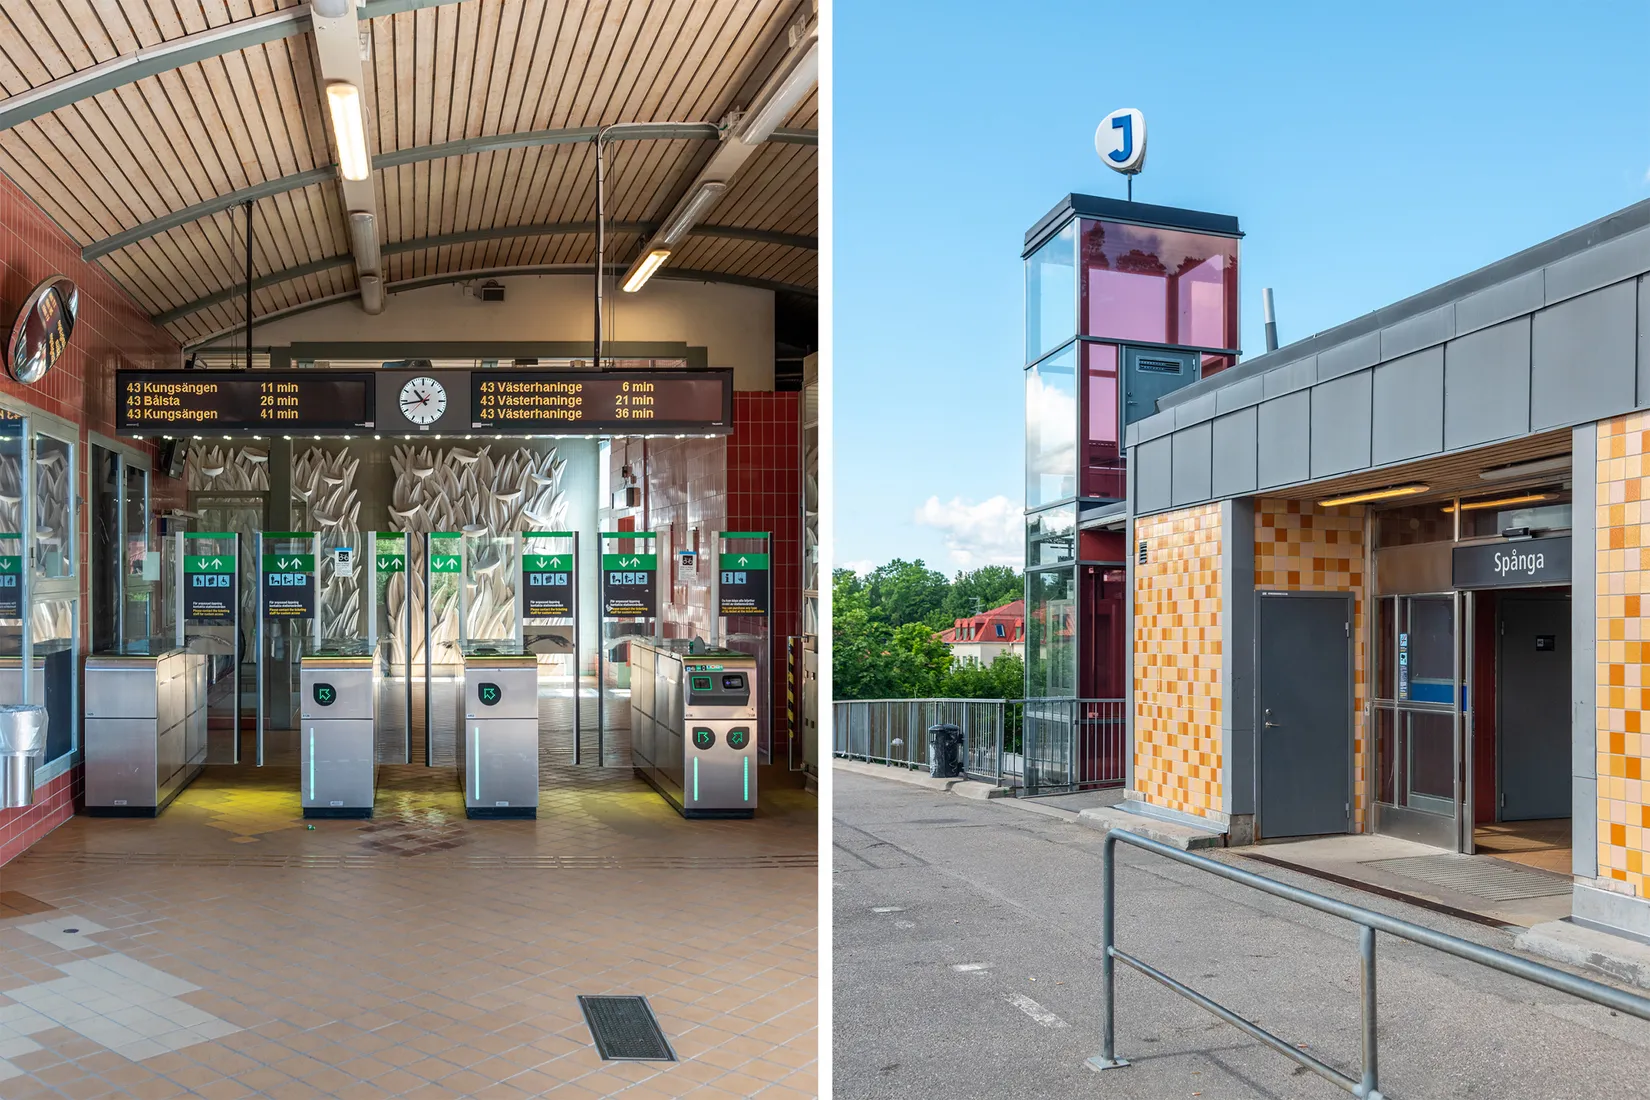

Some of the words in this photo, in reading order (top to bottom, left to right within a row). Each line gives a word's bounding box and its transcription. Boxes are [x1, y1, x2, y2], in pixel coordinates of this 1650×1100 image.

[1108, 114, 1133, 162] J
[127, 383, 141, 393] 43
[144, 383, 217, 395] Kungsängen
[261, 383, 273, 393] 11
[277, 383, 299, 393] min
[480, 382, 494, 393] 43
[497, 382, 583, 395] Västerhaninge
[622, 382, 630, 393] 6
[632, 382, 654, 393] min
[127, 396, 141, 406] 43
[144, 396, 180, 406] Bålsta
[261, 396, 273, 406] 26
[277, 396, 299, 406] min
[480, 395, 494, 406] 43
[497, 395, 583, 408] Västerhaninge
[615, 395, 629, 406] 21
[632, 395, 654, 406] min
[127, 409, 141, 419] 43
[144, 409, 217, 421] Kungsängen
[261, 409, 273, 419] 41
[277, 409, 299, 419] min
[480, 408, 494, 418] 43
[497, 408, 583, 421] Västerhaninge
[615, 408, 629, 418] 36
[632, 408, 654, 418] min
[1494, 549, 1545, 576] Spånga
